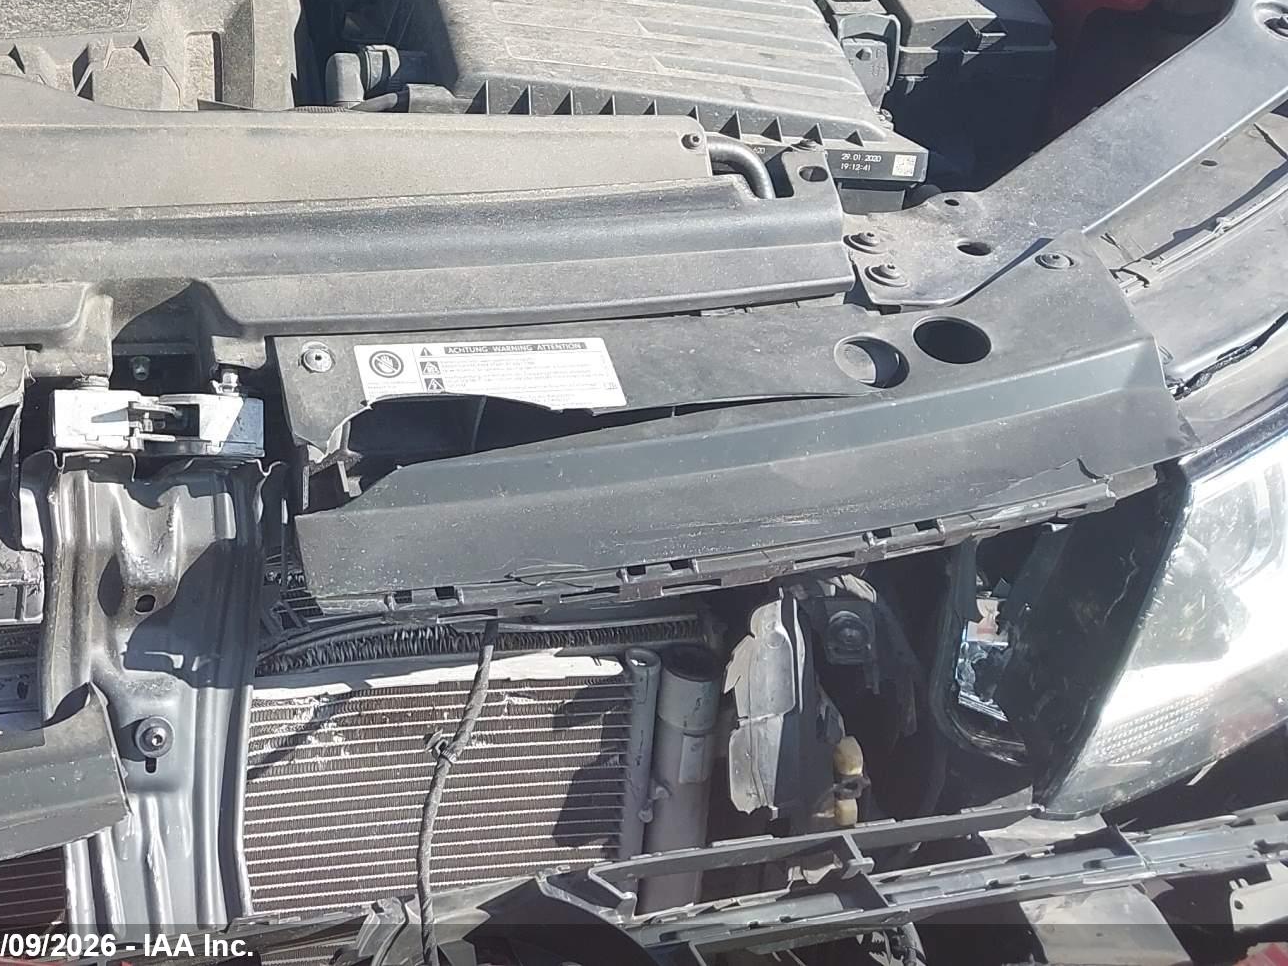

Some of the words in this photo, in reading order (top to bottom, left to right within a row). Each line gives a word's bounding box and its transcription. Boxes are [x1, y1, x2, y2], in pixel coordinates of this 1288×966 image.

[447, 345, 489, 354] ACHTUNG
[491, 344, 533, 353] WARNING
[536, 342, 582, 352] ATTENTION
